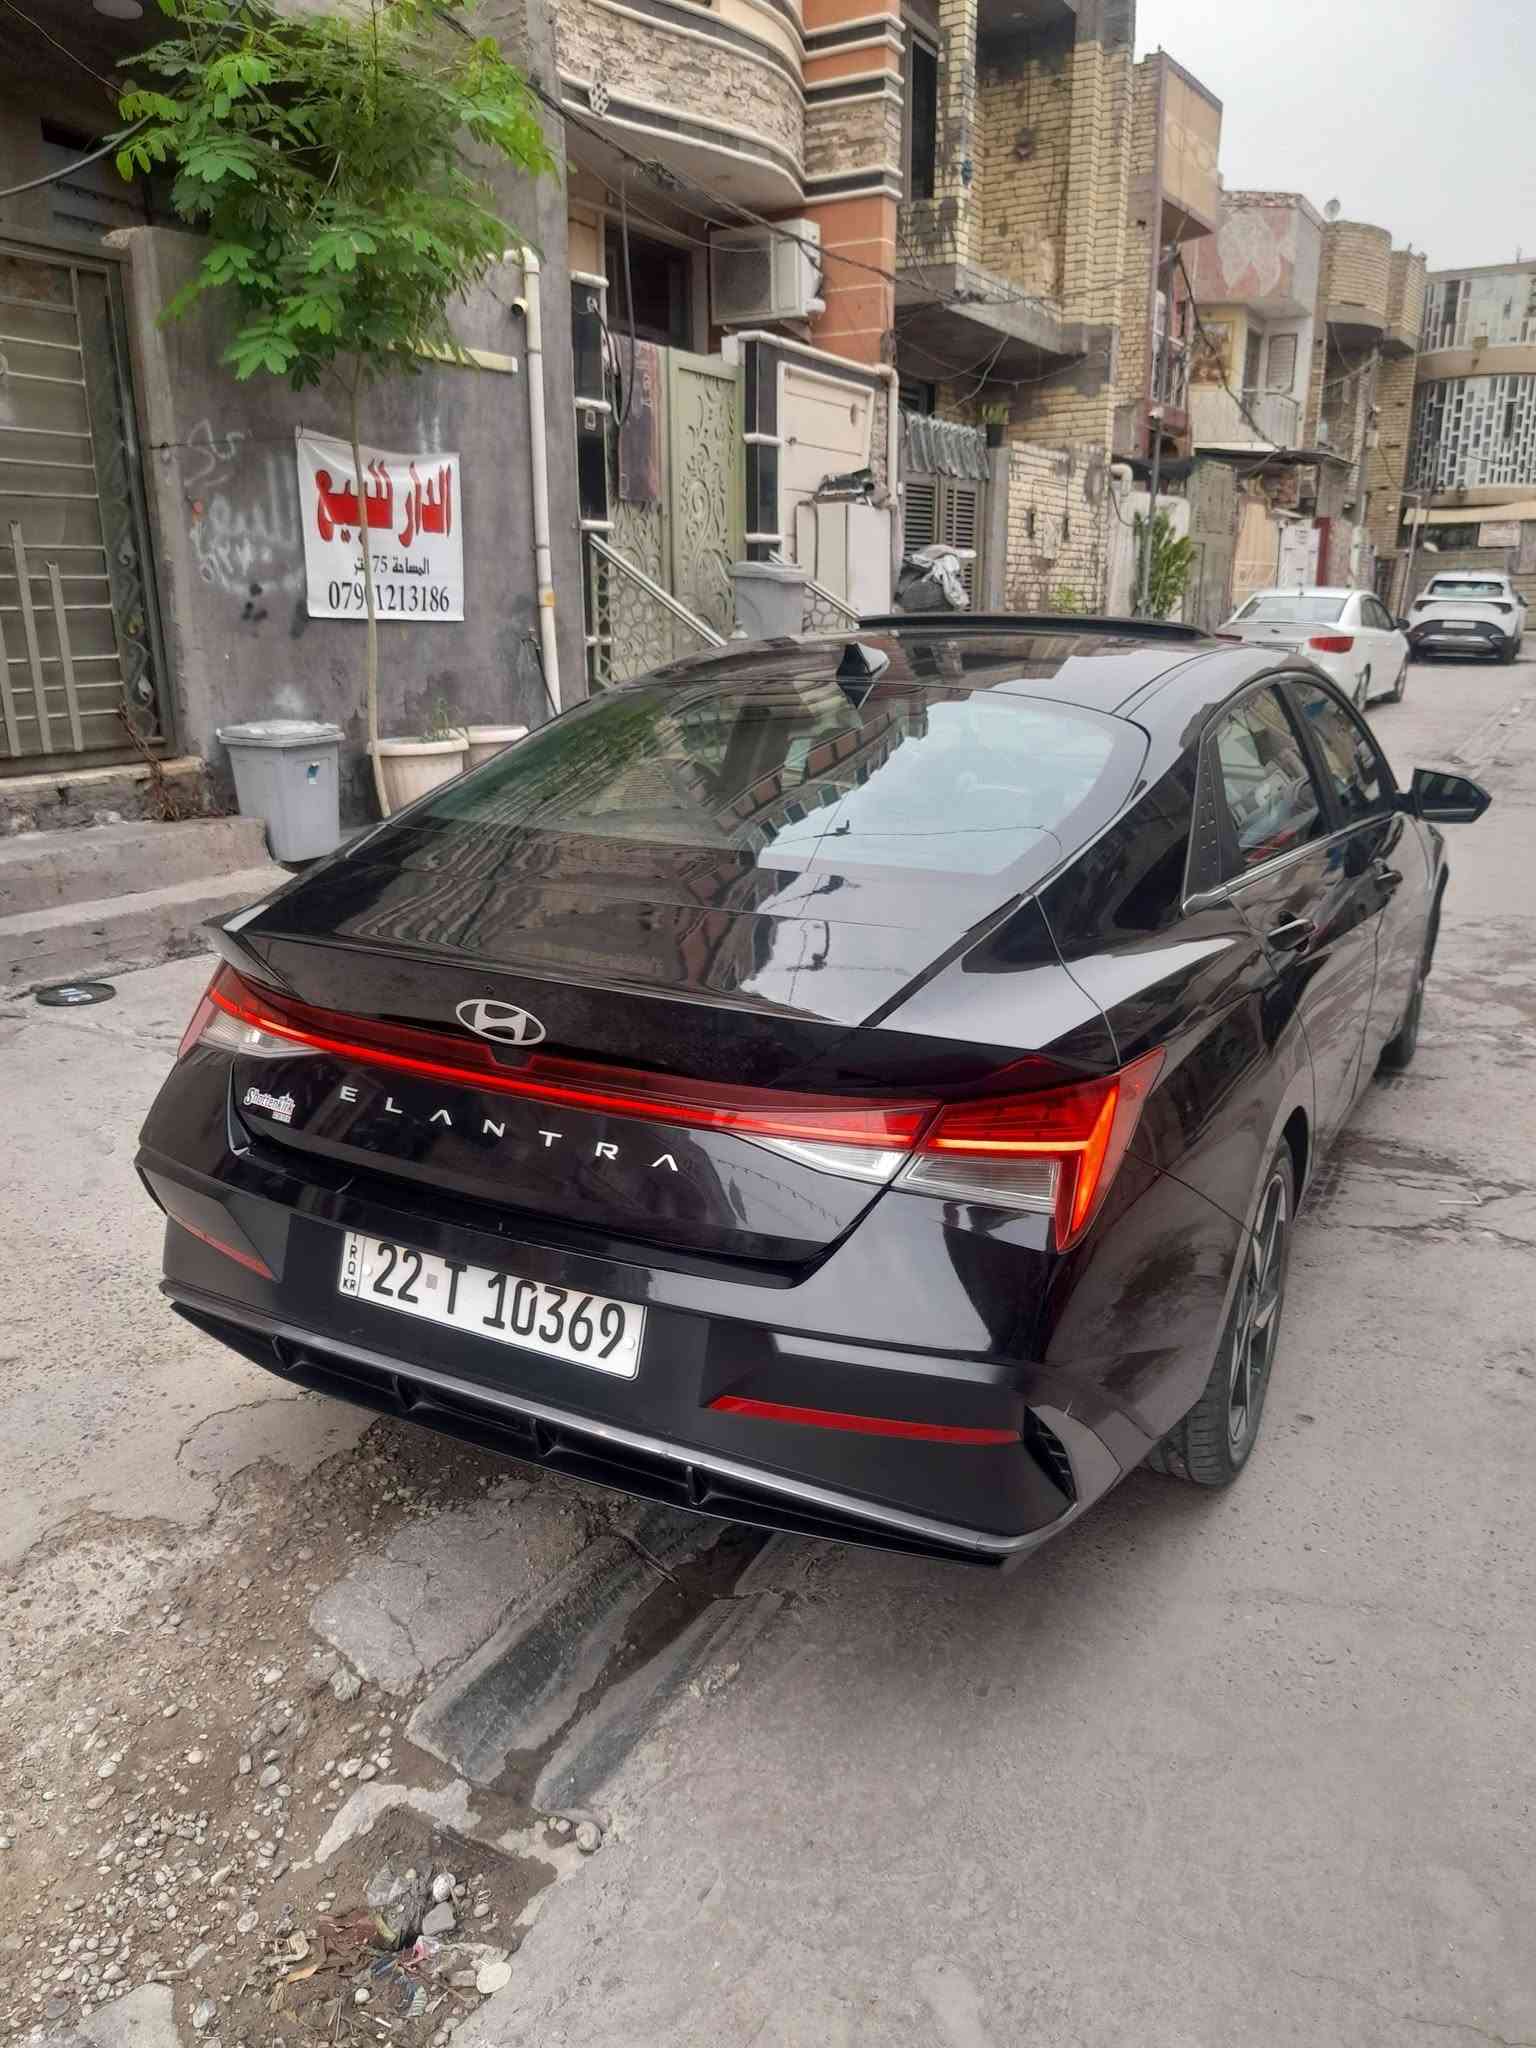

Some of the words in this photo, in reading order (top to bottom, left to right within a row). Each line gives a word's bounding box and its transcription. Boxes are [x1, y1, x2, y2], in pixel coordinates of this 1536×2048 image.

[315, 456, 394, 543] للبيع
[399, 461, 452, 547] الدار
[392, 555, 430, 576] المساحة
[339, 1084, 679, 1172] ELANTRA
[373, 1242, 424, 1304] 22
[444, 1259, 468, 1315] T
[482, 1273, 626, 1360] 10369
